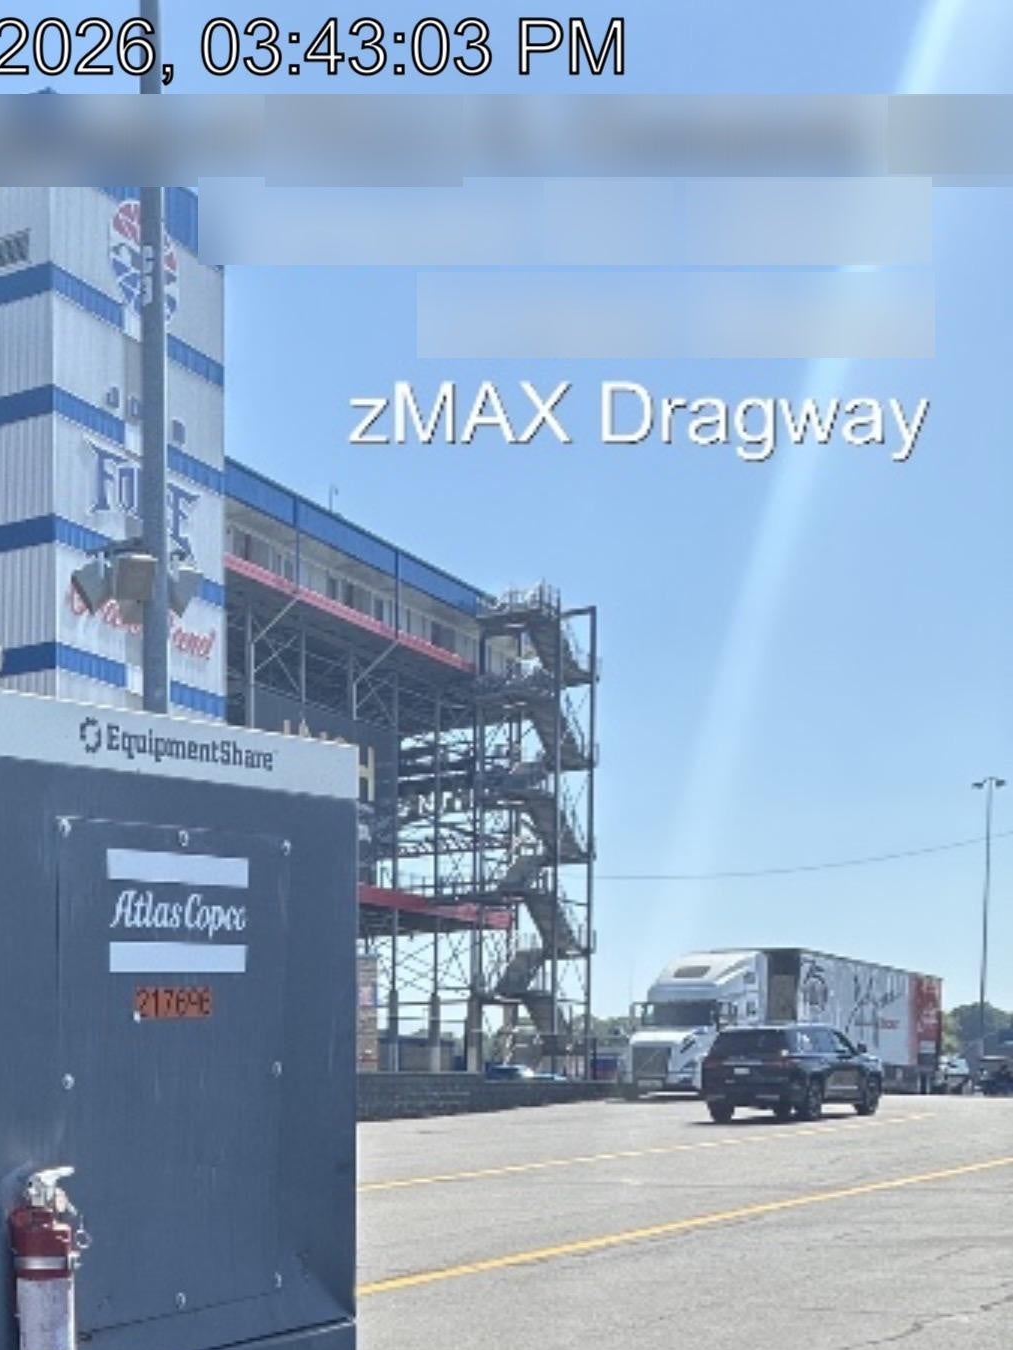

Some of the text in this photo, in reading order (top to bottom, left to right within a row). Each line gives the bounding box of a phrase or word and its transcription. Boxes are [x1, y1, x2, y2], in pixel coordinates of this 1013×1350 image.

[106, 722, 274, 771] EquipmentShare
[109, 889, 246, 939] Atlas Copco
[136, 985, 210, 1017] 217696
